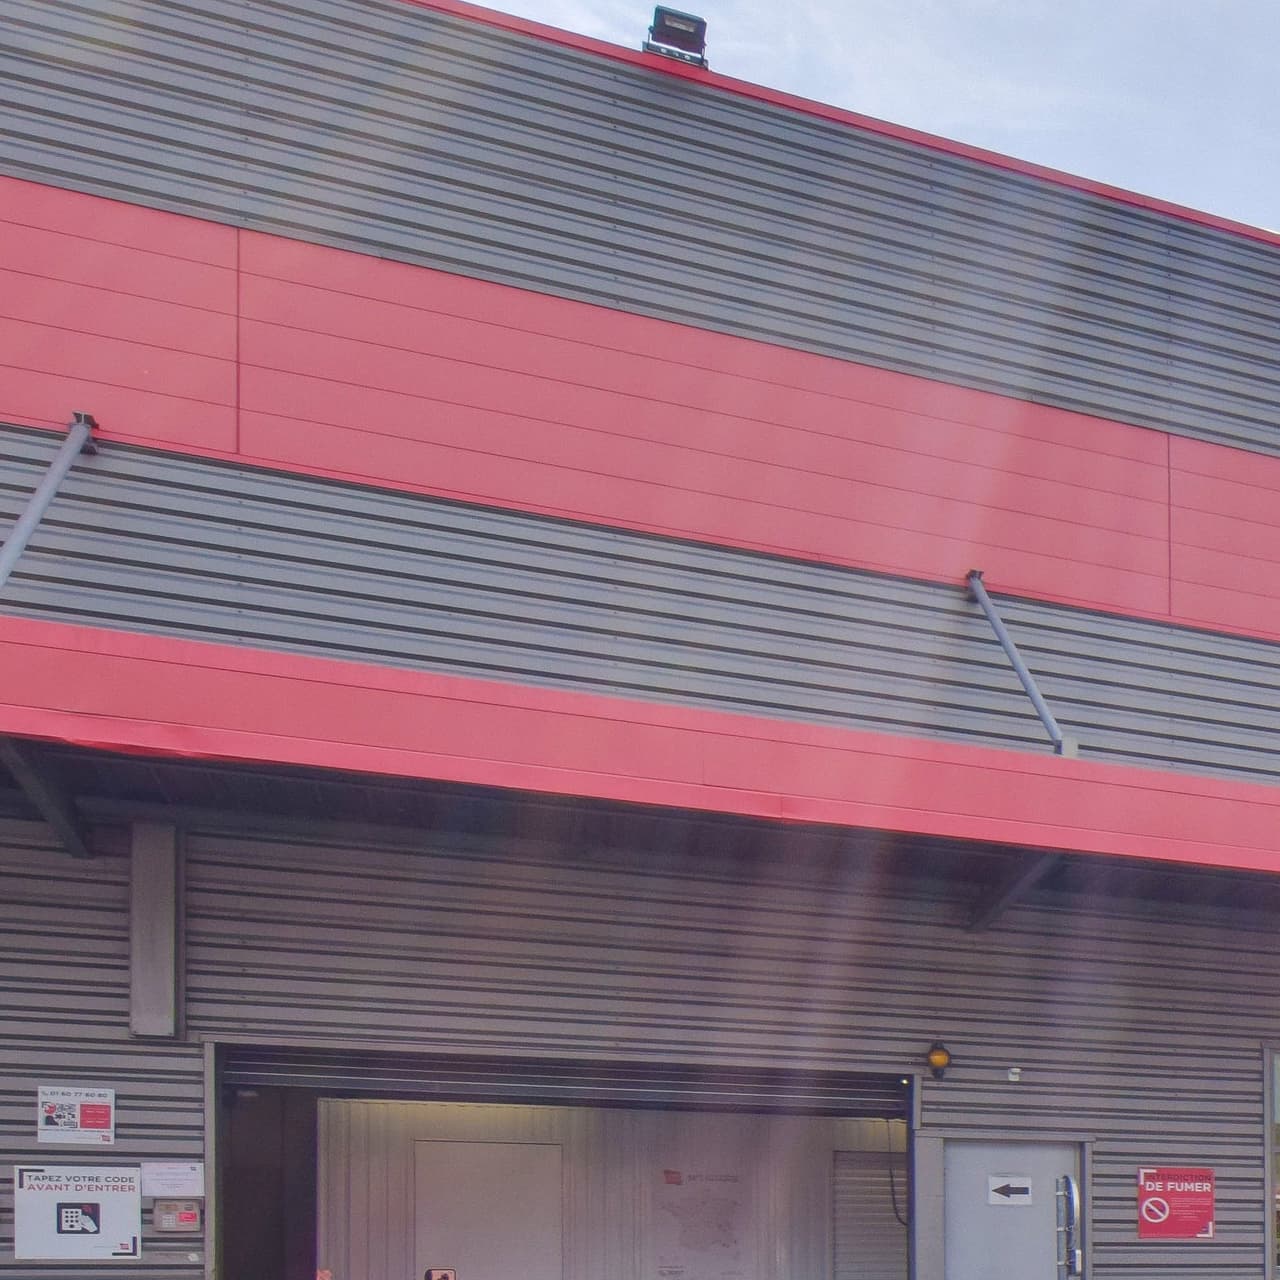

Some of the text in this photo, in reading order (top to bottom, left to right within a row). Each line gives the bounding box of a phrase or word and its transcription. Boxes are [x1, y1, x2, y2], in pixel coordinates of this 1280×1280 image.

[65, 1175, 101, 1183] VOTRE
[75, 1184, 136, 1192] D'ENTRER
[1145, 1182, 1212, 1192] DE FUMER
